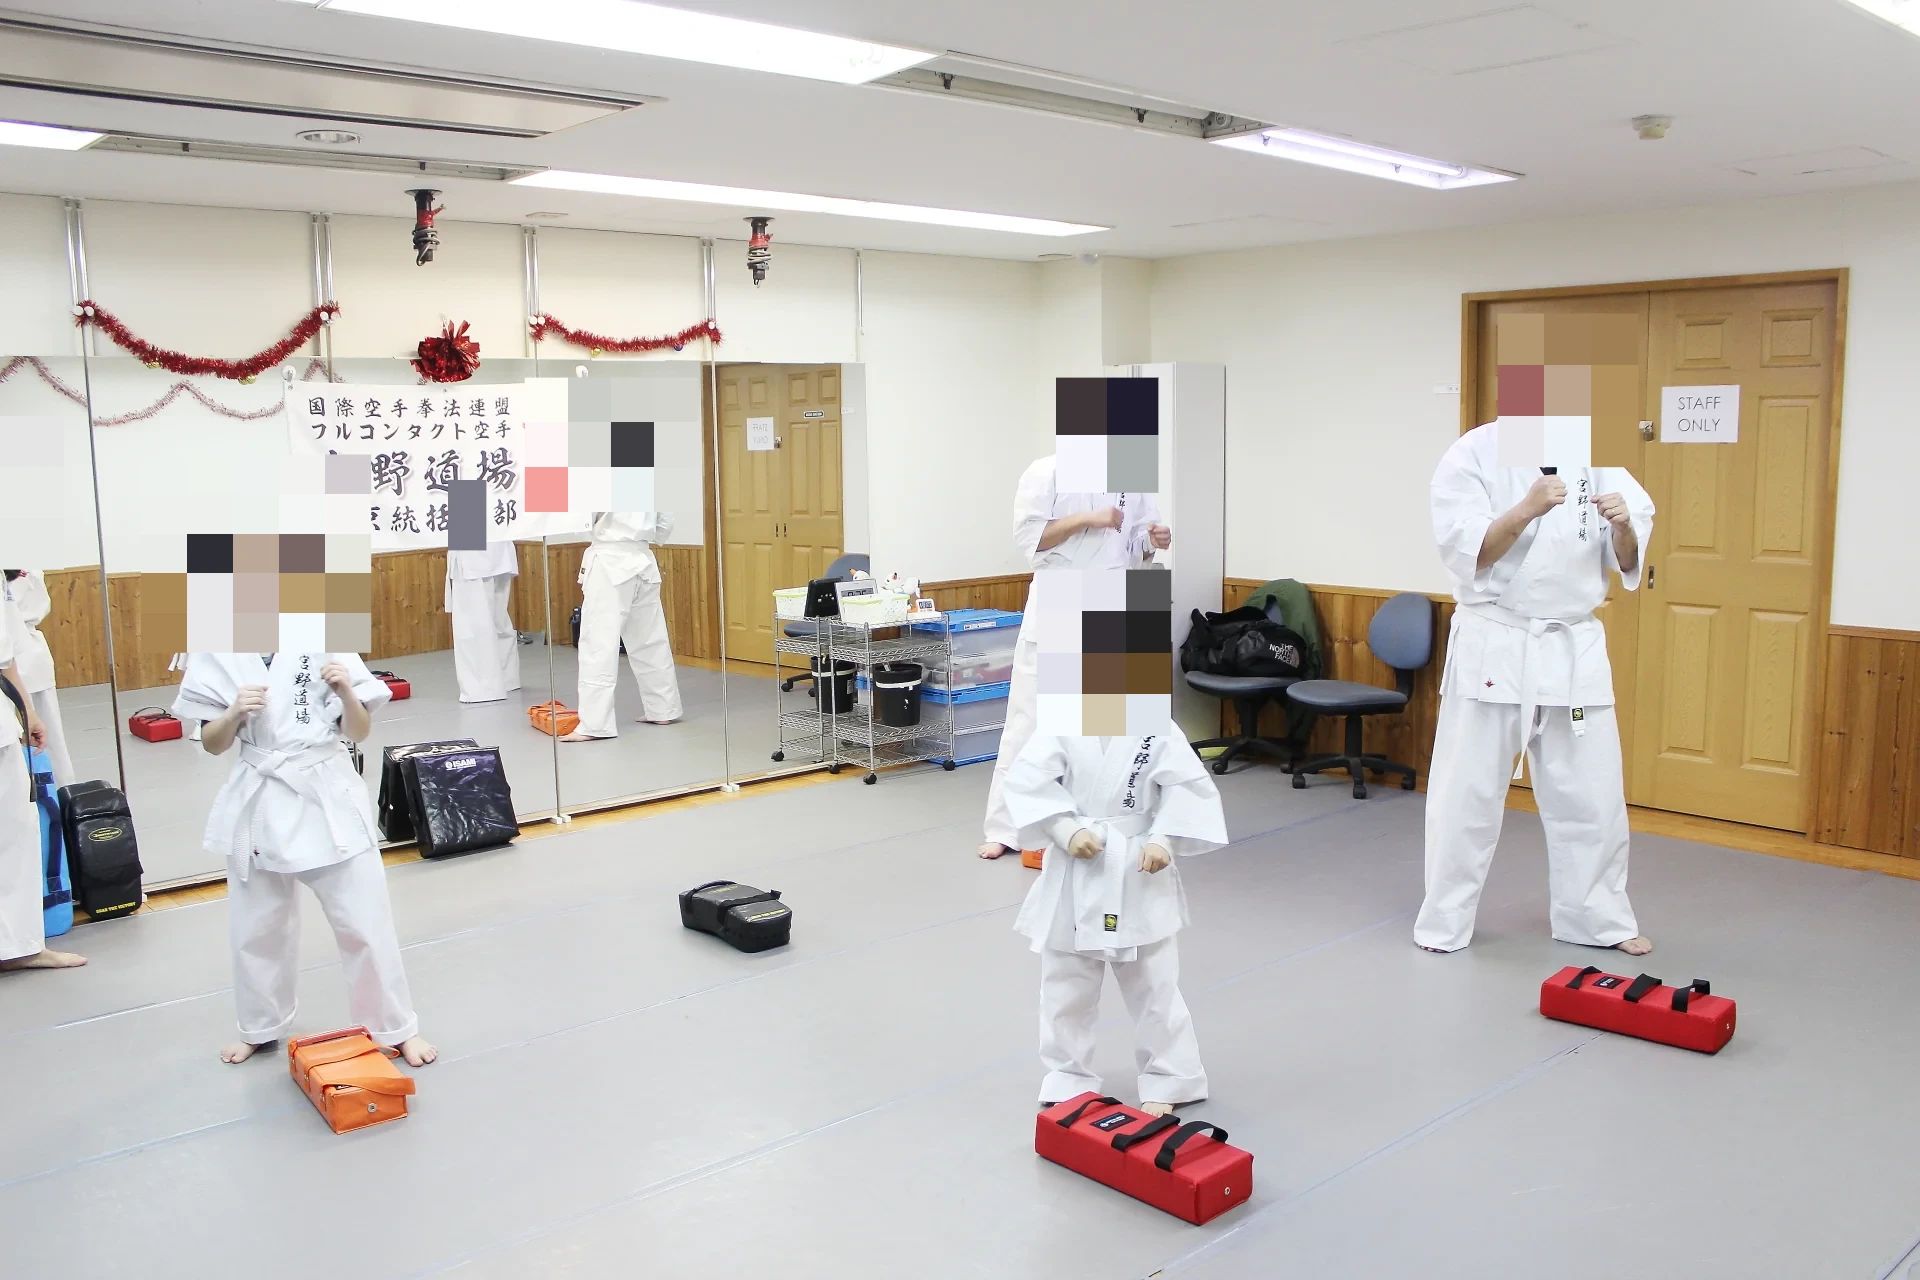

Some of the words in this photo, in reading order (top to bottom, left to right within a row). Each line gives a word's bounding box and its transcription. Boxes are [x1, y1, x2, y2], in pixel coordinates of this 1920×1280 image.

[308, 396, 511, 418] 国際空手拳法連盟
[1678, 396, 1721, 410] STAFF
[311, 420, 511, 441] フルコンタクト空手
[1678, 418, 1720, 432] ONLY
[329, 447, 516, 495] 野道場
[453, 757, 477, 767] ISAMI
